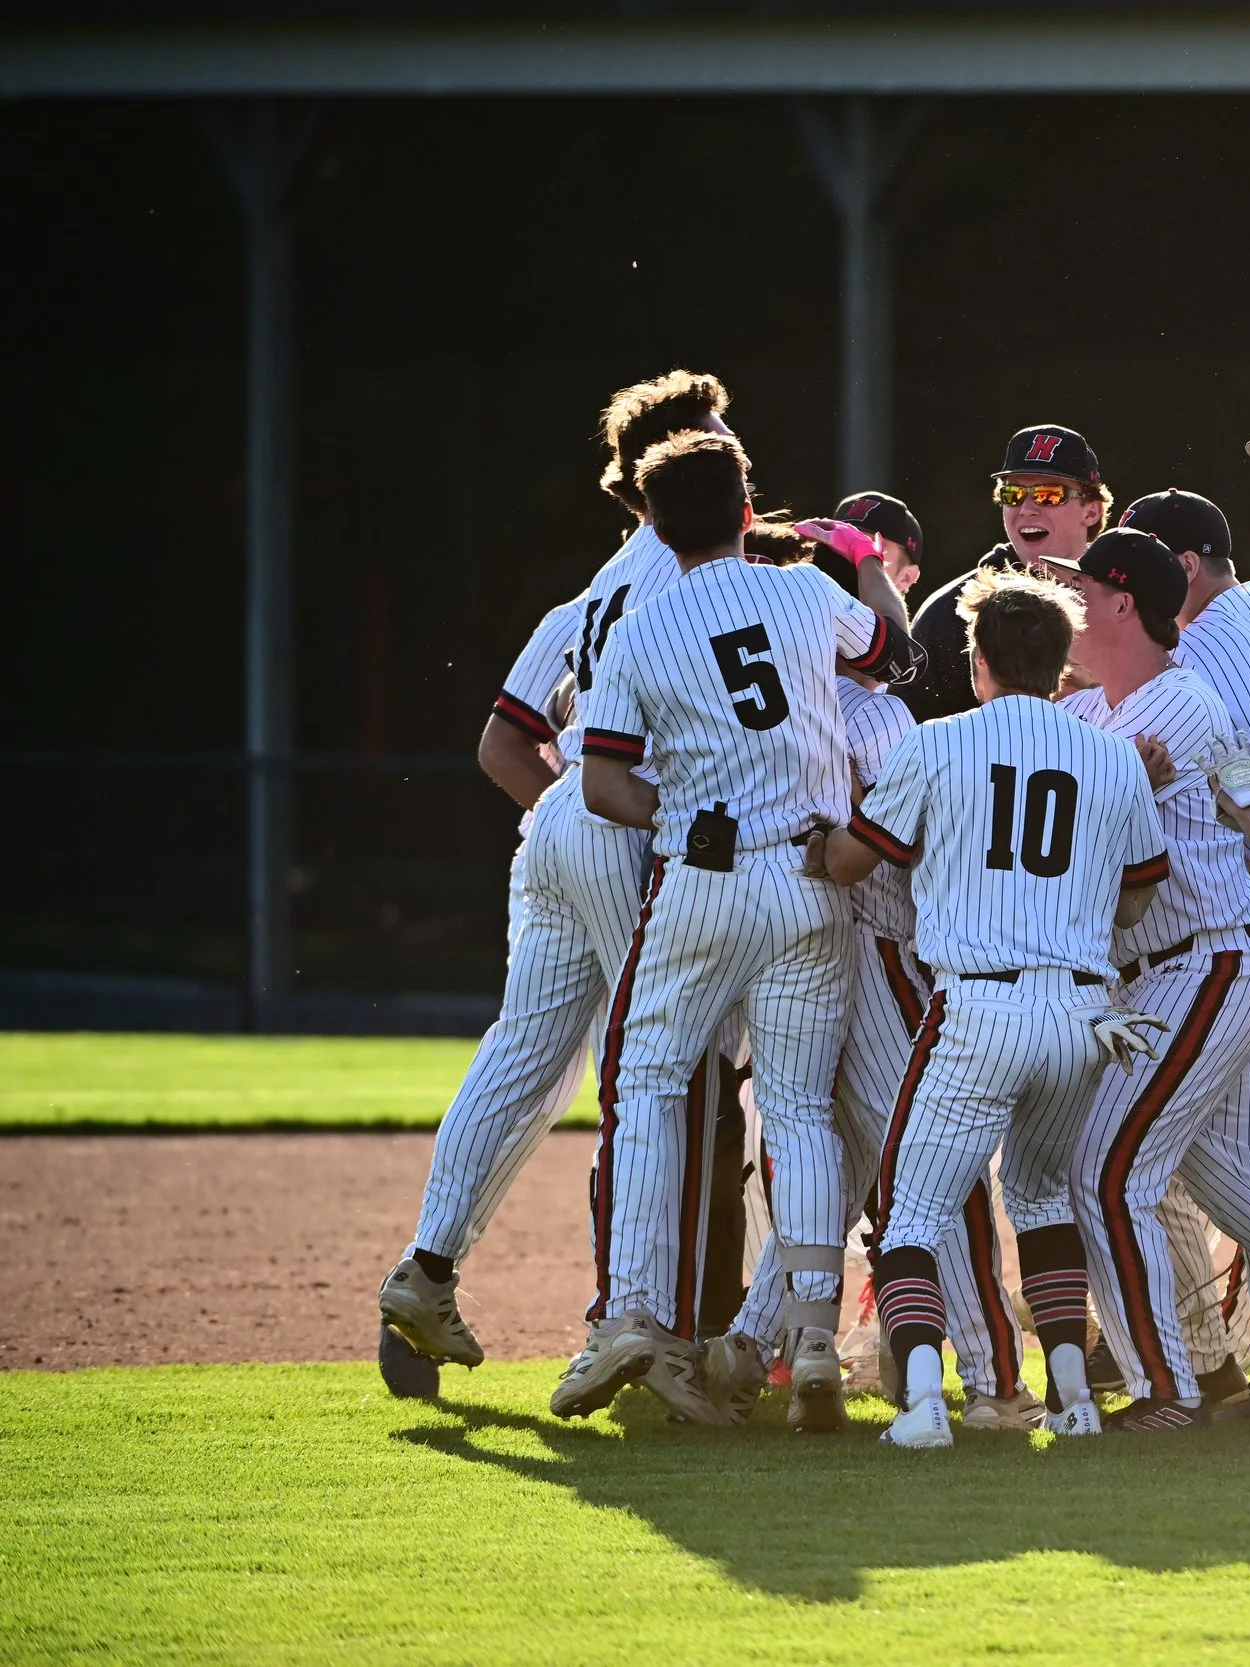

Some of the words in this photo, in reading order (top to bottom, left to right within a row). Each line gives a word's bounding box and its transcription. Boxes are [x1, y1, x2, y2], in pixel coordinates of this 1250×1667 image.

[1024, 434, 1062, 463] H
[709, 622, 790, 731] 5
[986, 762, 1079, 878] 10
